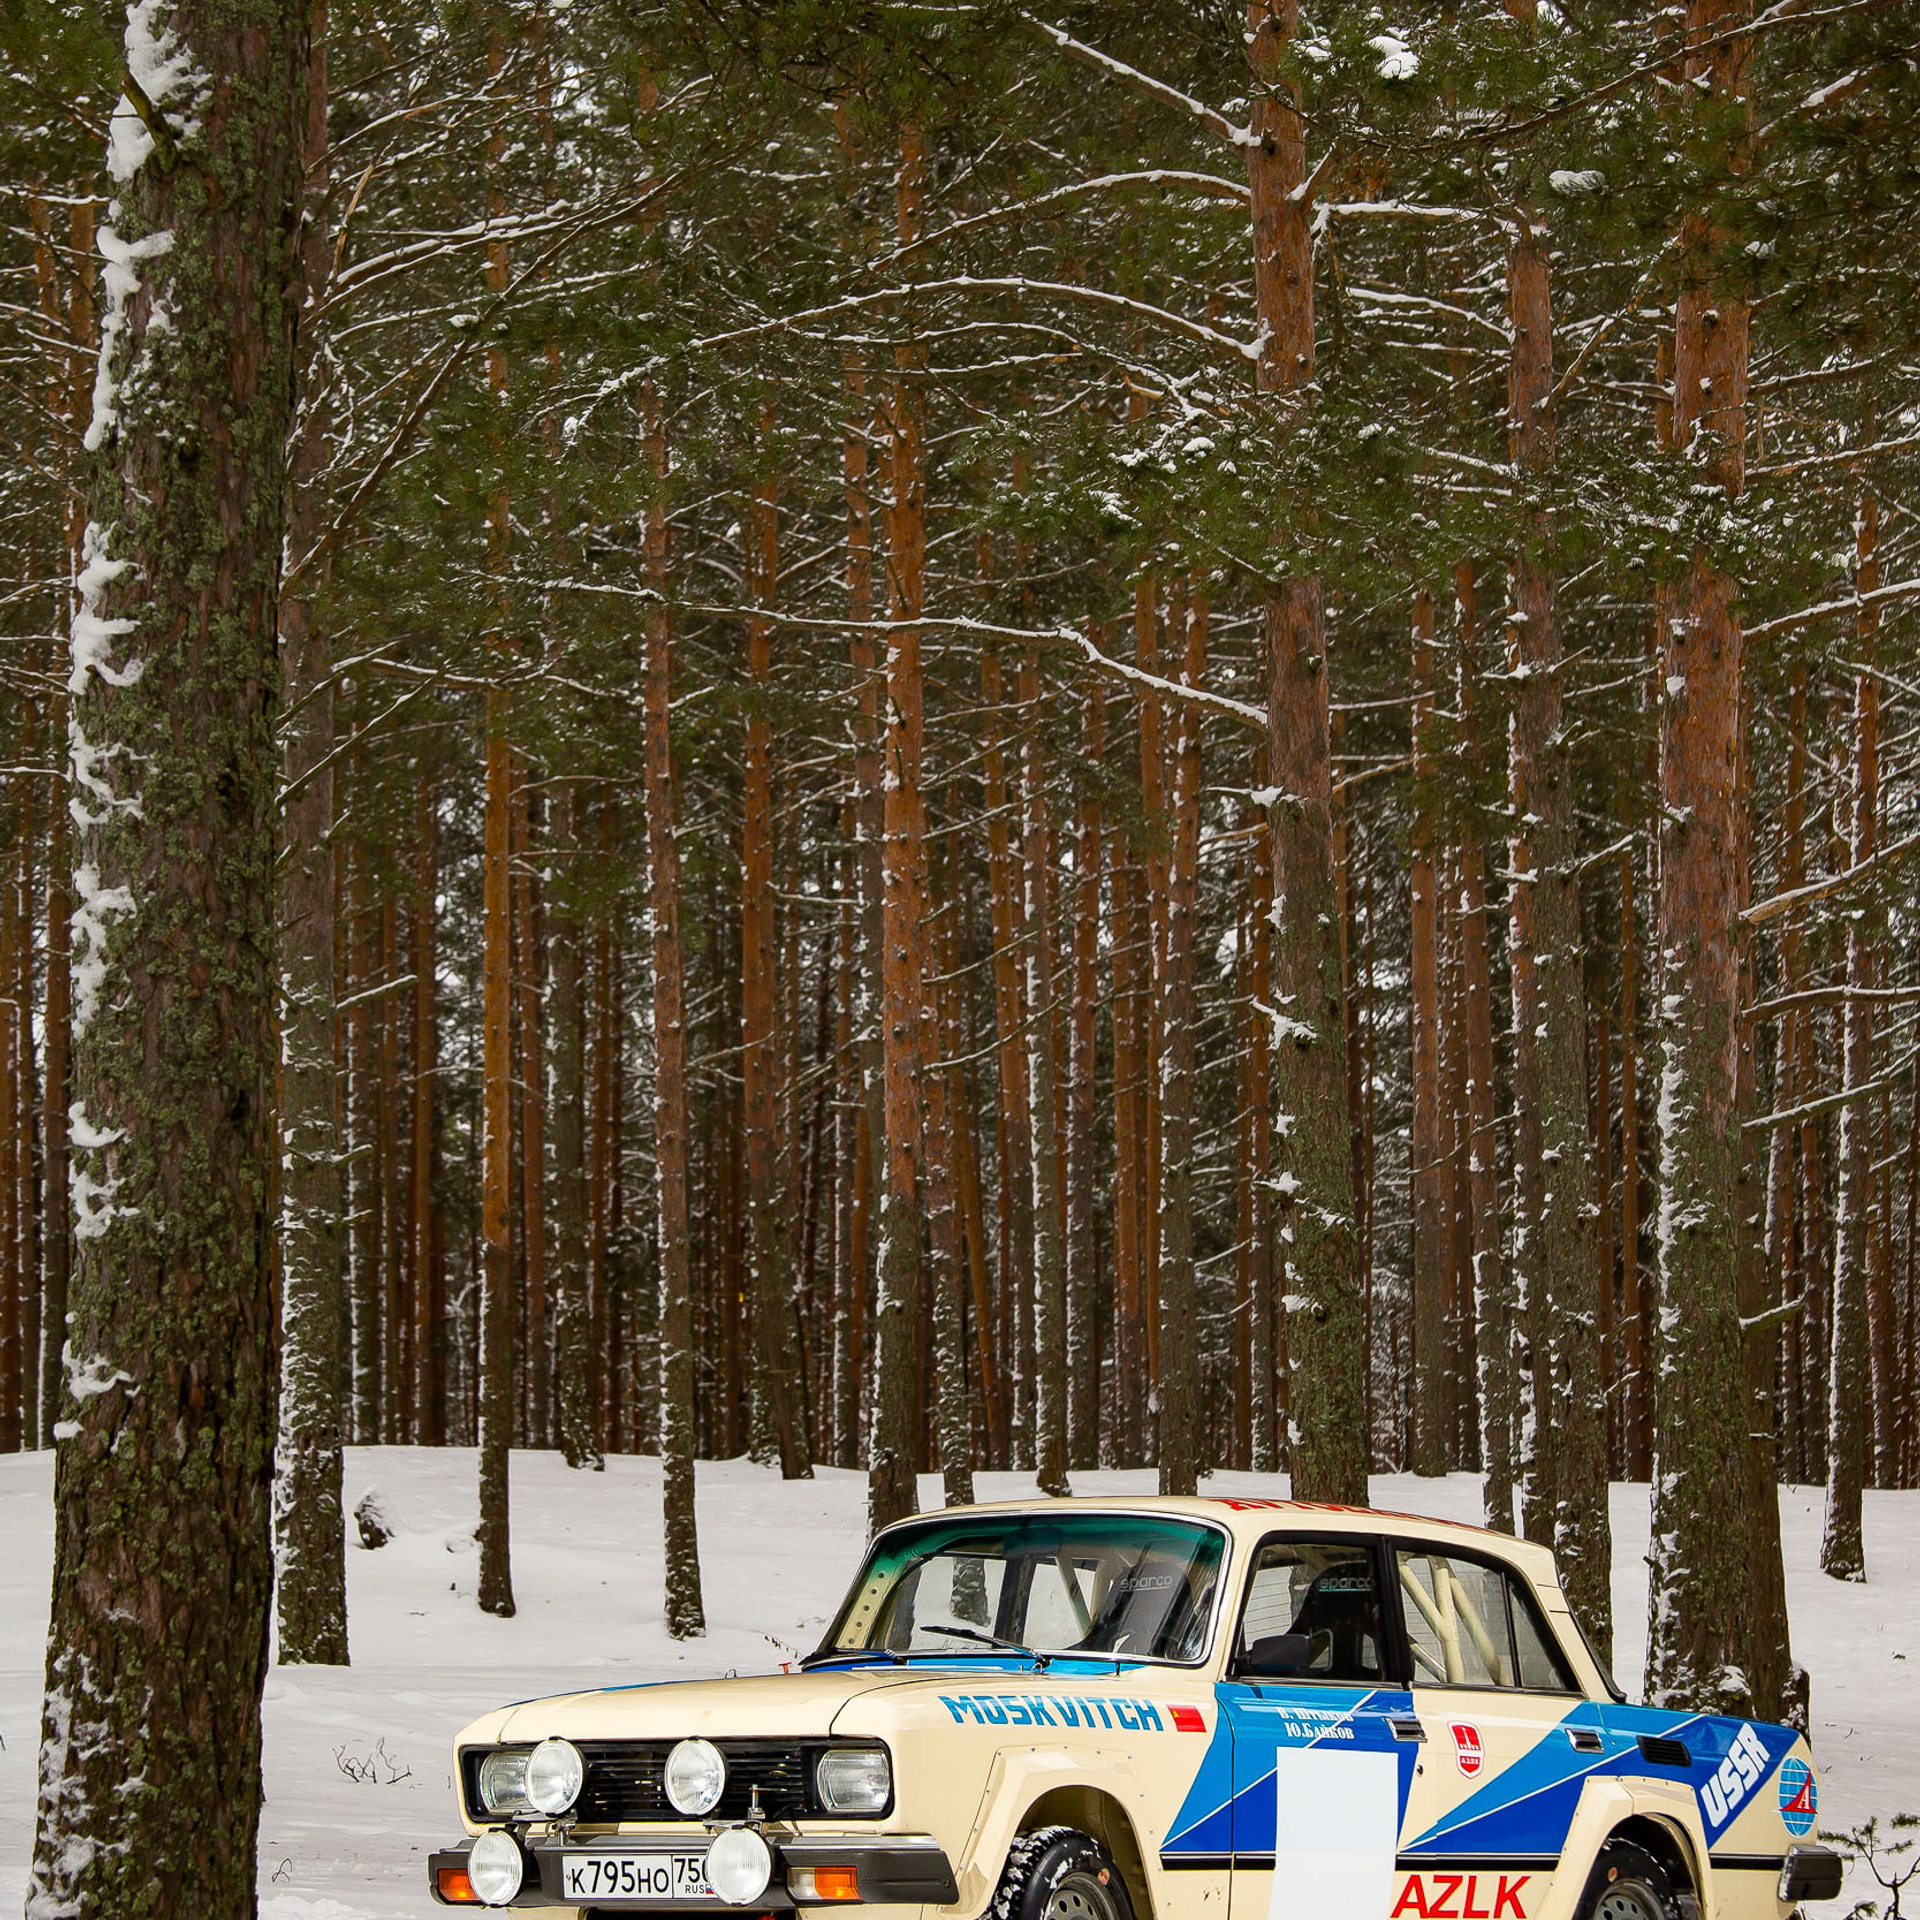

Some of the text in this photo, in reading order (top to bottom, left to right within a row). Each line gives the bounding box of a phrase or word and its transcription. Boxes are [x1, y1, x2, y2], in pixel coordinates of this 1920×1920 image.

[1120, 1575, 1173, 1590] sparco
[1320, 1577, 1375, 1592] sparco
[938, 1696, 1164, 1731] MOSKVITCH
[1700, 1722, 1770, 1828] USSR
[685, 1885, 705, 1894] RUS
[1390, 1874, 1532, 1919] AZLK
